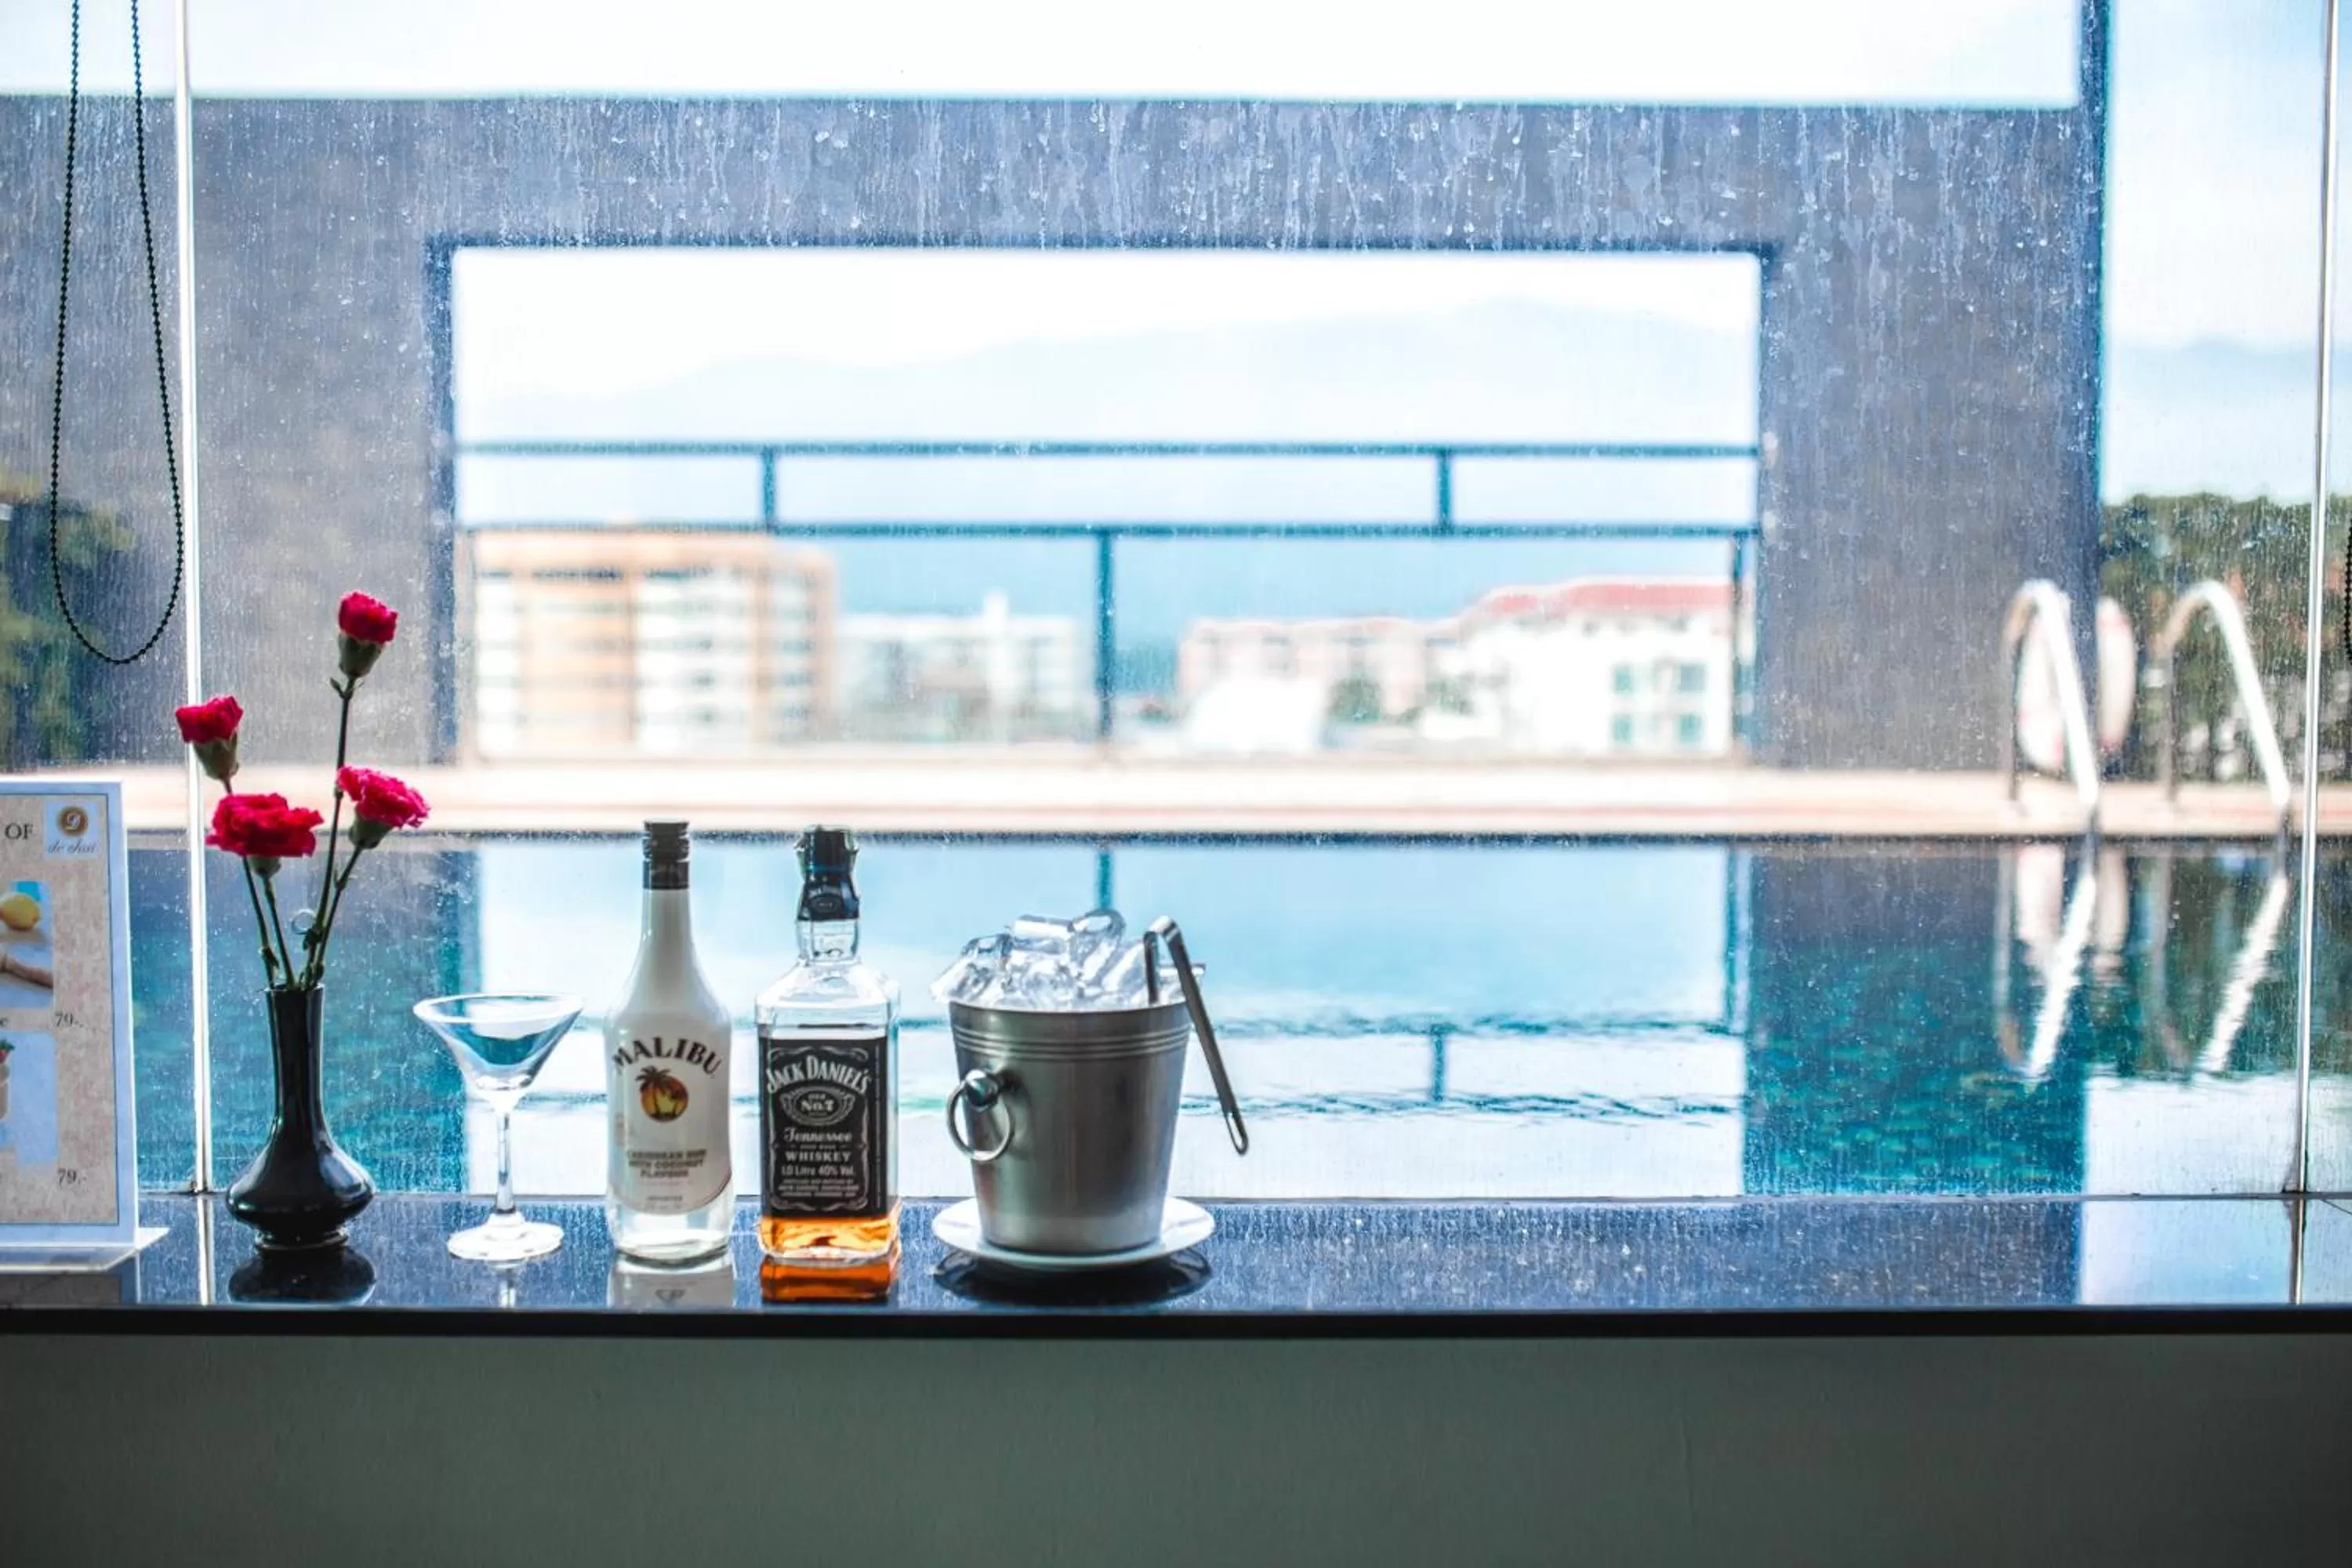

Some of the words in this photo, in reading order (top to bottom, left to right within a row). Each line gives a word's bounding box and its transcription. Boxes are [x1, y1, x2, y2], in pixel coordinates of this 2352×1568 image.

[5, 822, 33, 840] OF
[612, 1036, 722, 1076] MALIBU
[766, 1062, 806, 1094] JACK
[806, 1054, 872, 1094] DANIEL'S
[784, 1127, 852, 1142] Tennessee
[785, 1150, 851, 1162] WHISKEY
